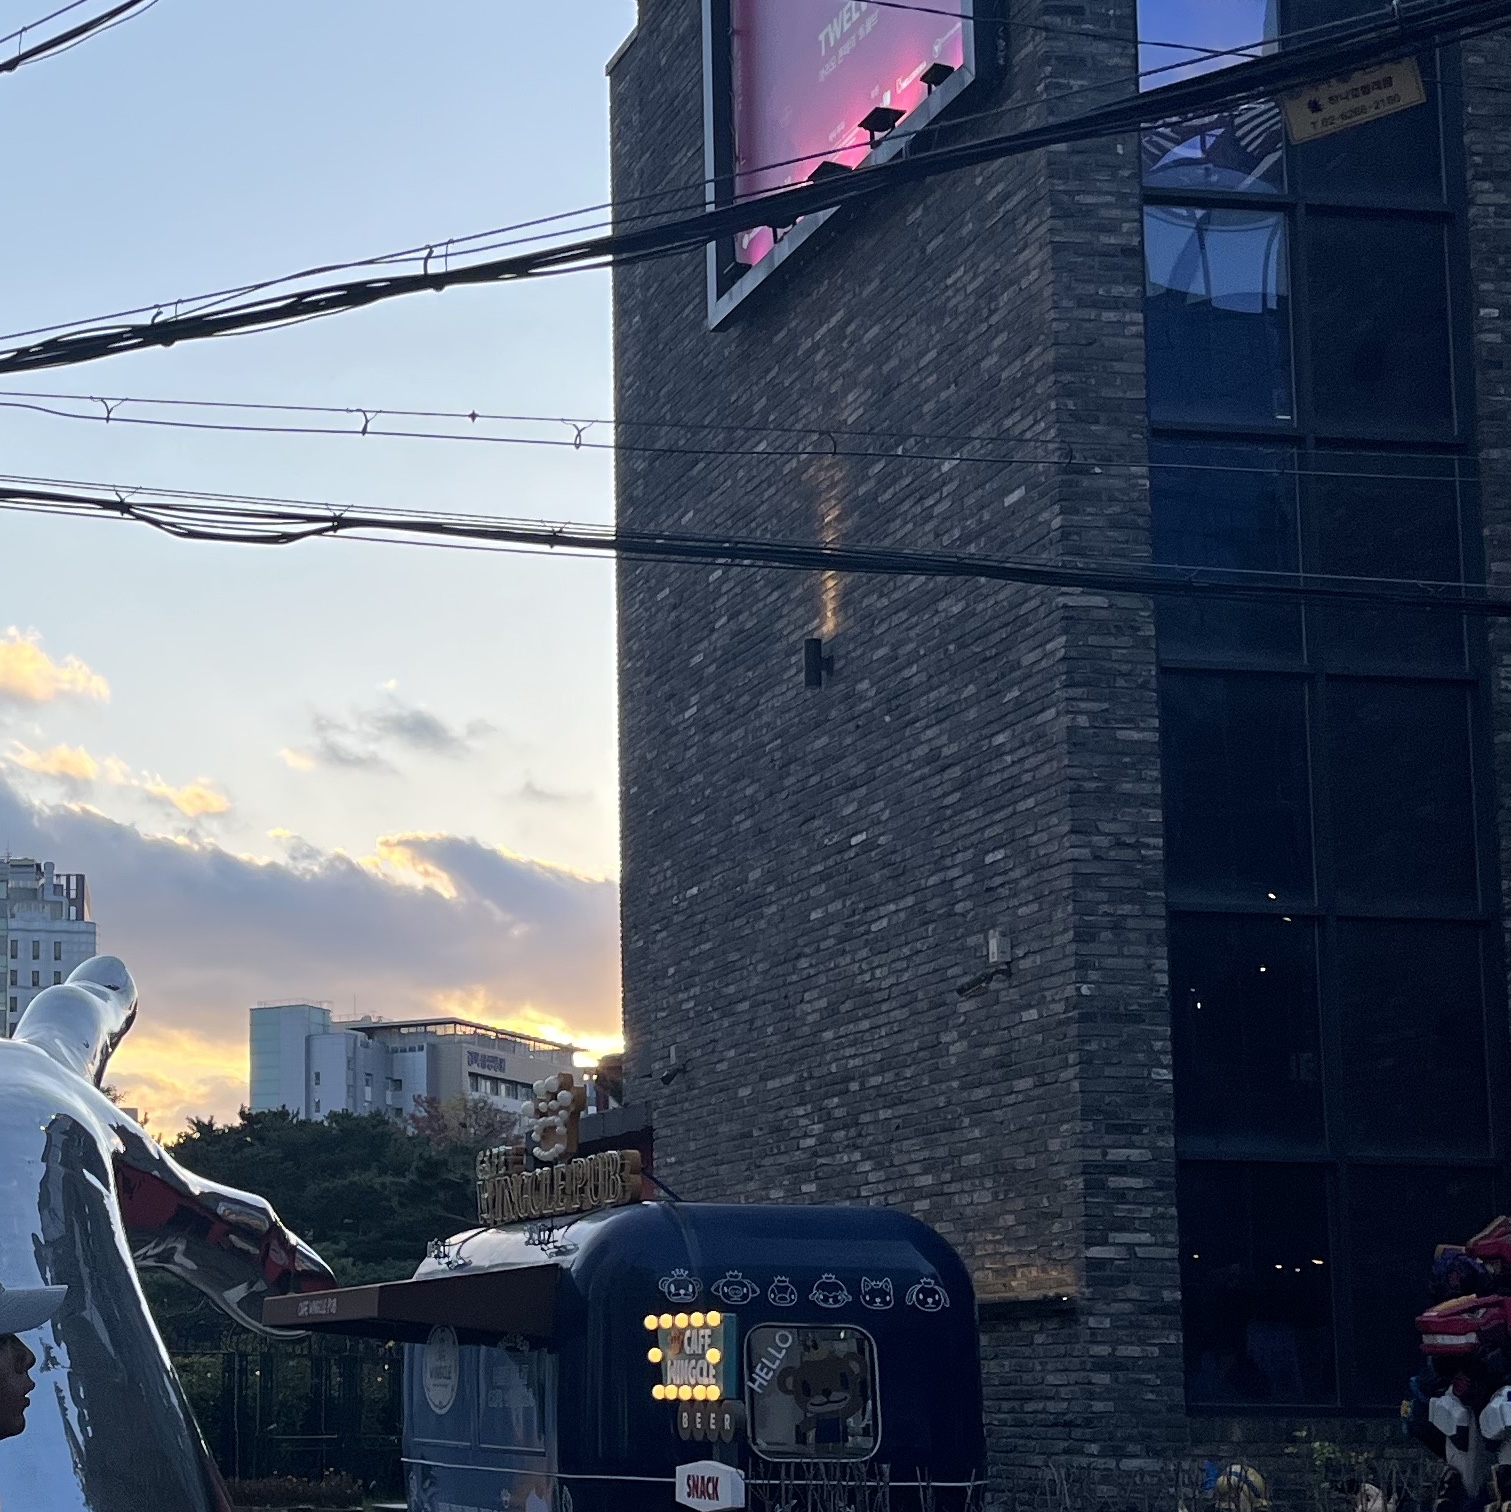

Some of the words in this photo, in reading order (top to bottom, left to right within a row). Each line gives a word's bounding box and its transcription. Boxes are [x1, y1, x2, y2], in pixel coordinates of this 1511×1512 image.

[746, 1330, 792, 1394] HELLO
[682, 1412, 731, 1430] BEER
[686, 1474, 719, 1501] SNACK
